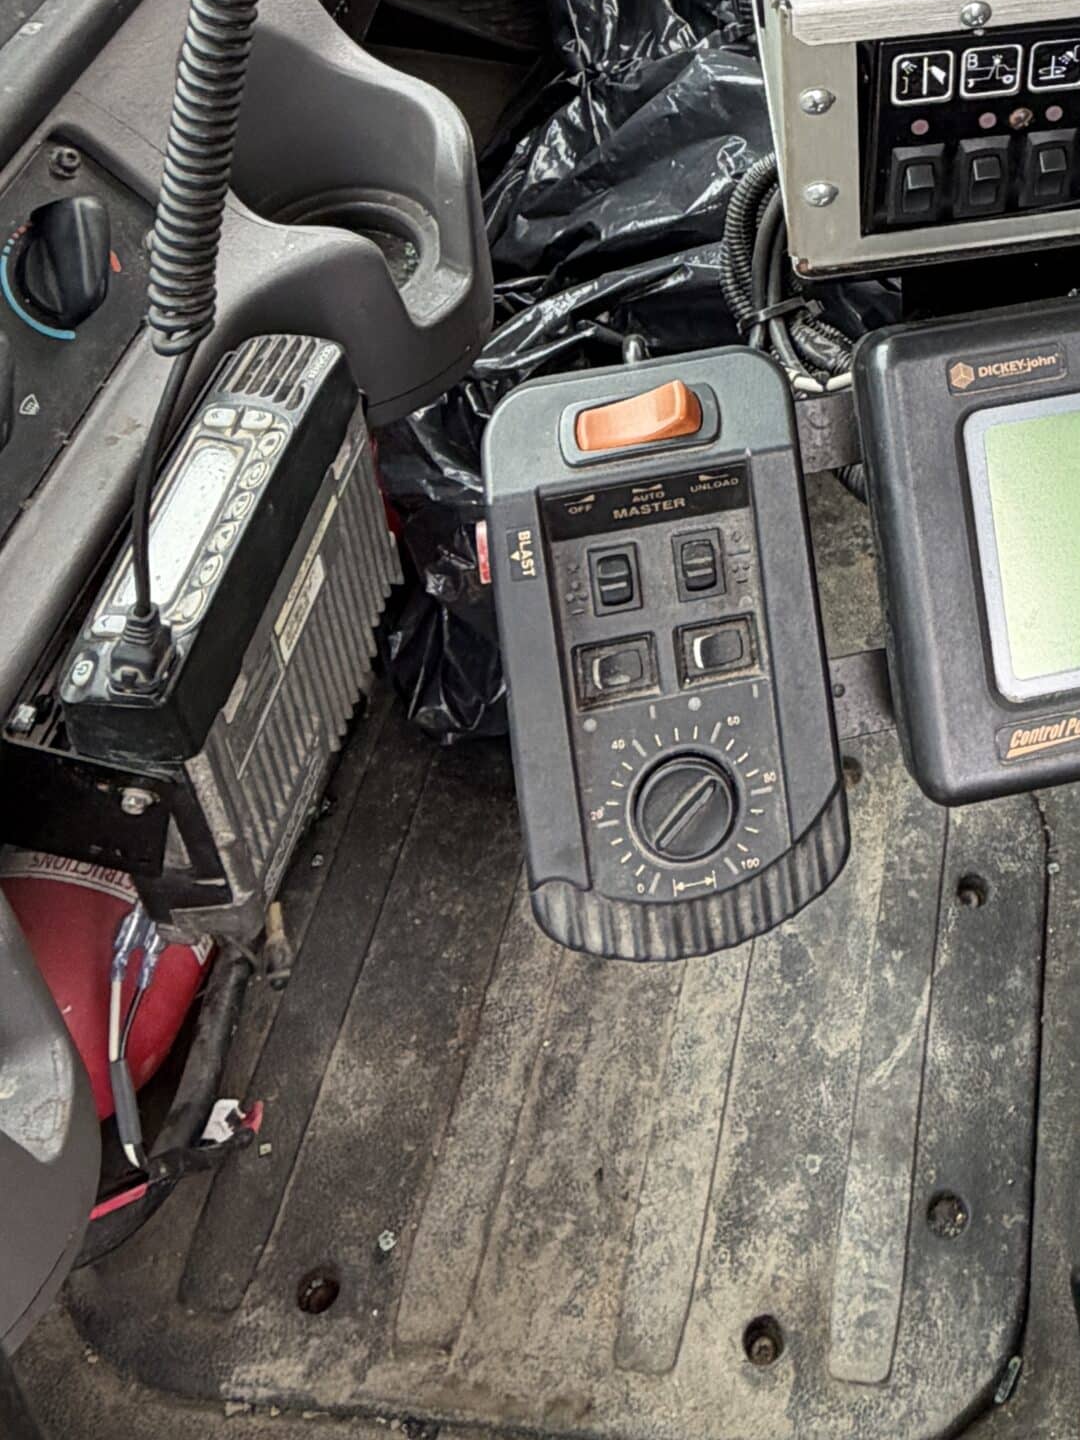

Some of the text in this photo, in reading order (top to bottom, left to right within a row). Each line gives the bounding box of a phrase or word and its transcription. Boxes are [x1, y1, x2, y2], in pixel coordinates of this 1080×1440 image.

[689, 476, 739, 493] UNLOAD
[631, 490, 665, 503] AUTO
[568, 503, 595, 514] OFF
[612, 496, 687, 521] MASTER
[517, 529, 536, 578] BLAST
[726, 714, 741, 727] 60
[1009, 718, 1067, 749] Control
[610, 738, 626, 751] 40
[740, 856, 760, 870] 100
